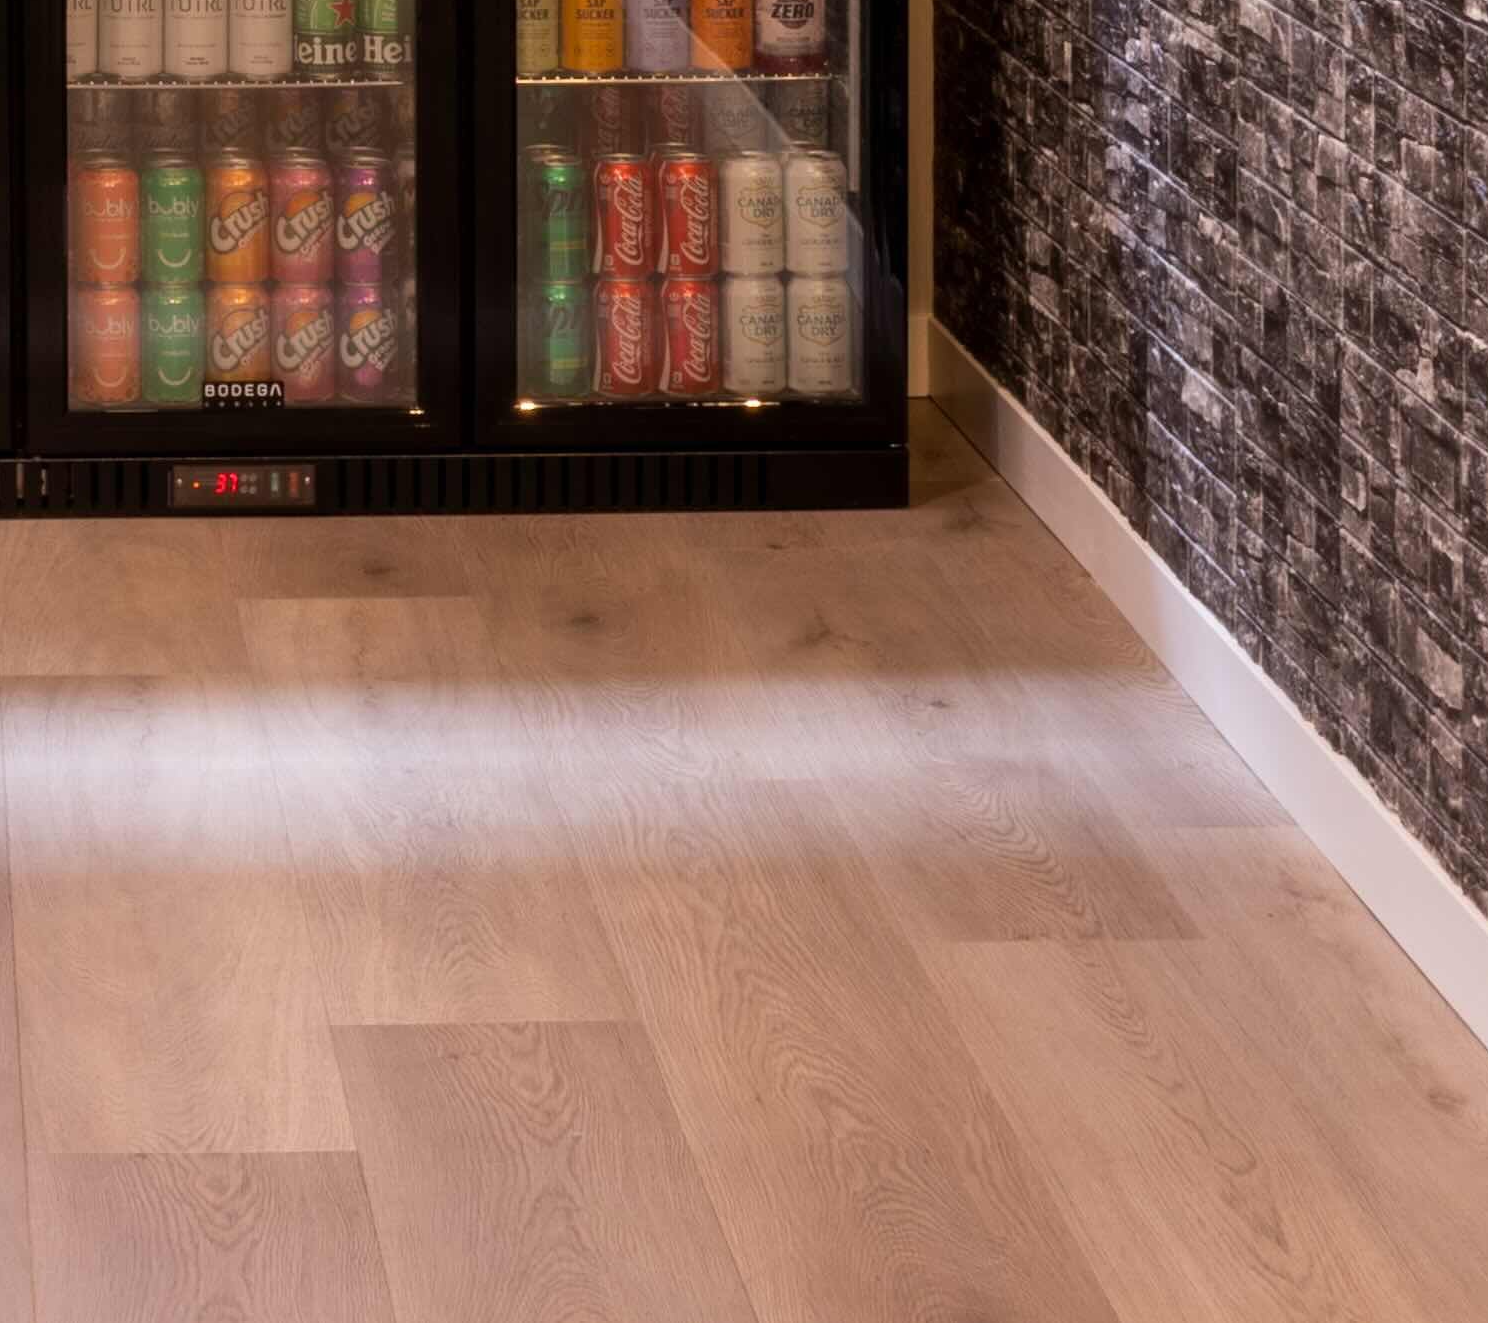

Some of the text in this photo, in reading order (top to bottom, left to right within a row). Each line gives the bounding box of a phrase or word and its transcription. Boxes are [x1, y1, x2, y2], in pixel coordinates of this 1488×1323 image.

[574, 9, 614, 19] SUCKER
[705, 9, 744, 18] SUCKER
[771, 3, 814, 19] ZERO
[211, 190, 268, 252] Crush
[276, 190, 333, 252] Crush
[337, 190, 394, 250] Crush
[212, 309, 268, 370] Crush
[277, 310, 333, 370] Crush
[340, 309, 396, 368] Crush
[204, 384, 282, 398] BODEGA
[215, 473, 238, 494] 37
